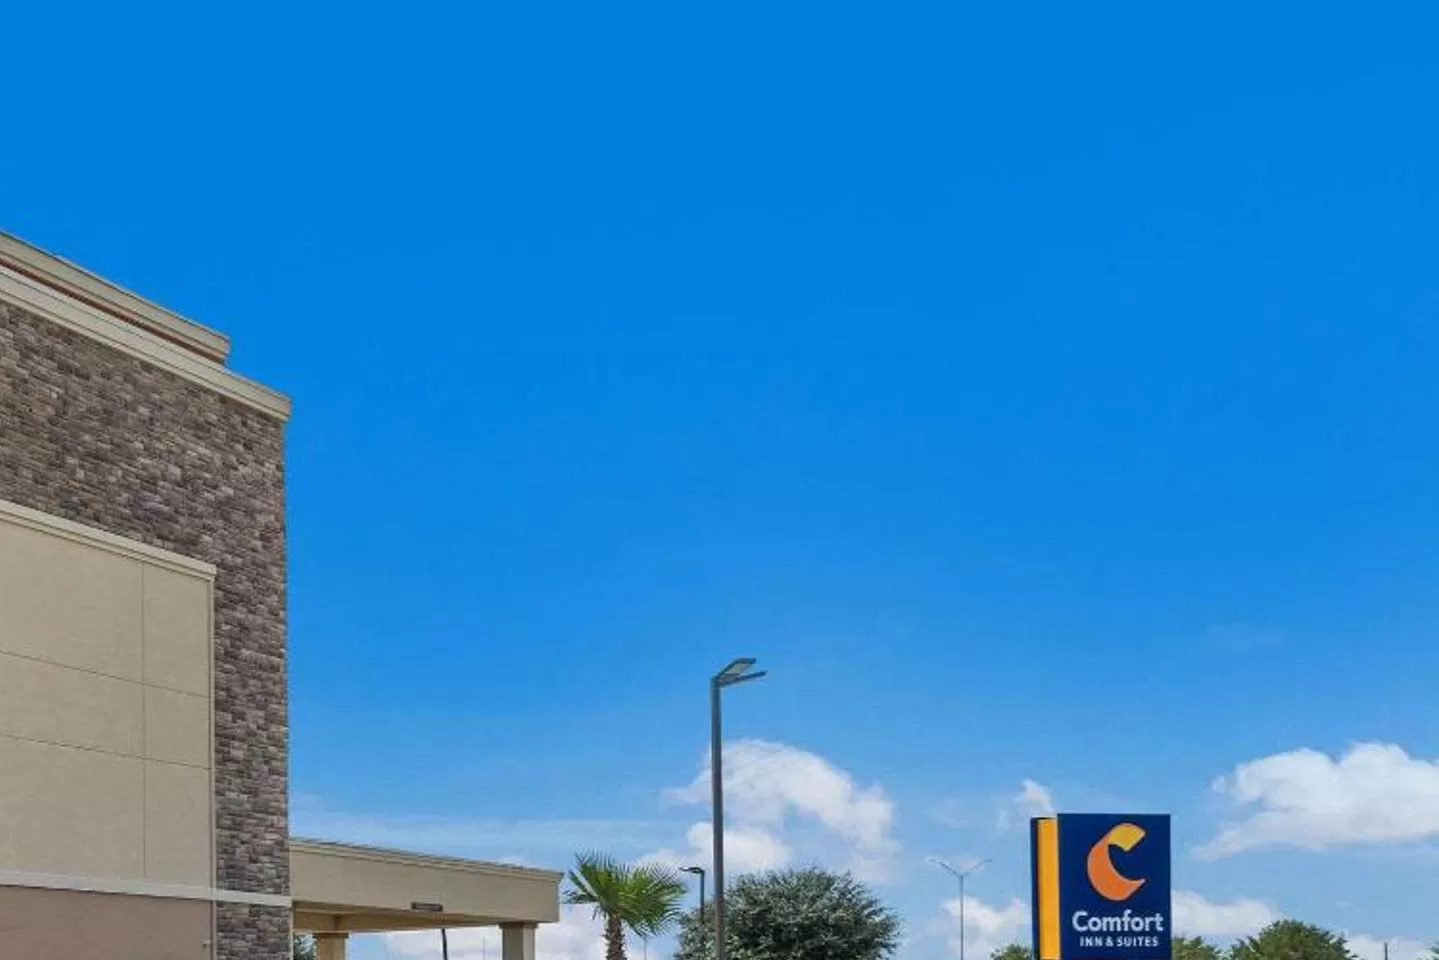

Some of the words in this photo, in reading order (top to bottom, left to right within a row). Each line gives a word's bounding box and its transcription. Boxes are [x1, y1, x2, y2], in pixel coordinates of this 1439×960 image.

[1071, 908, 1164, 932] Comfort
[1079, 935, 1103, 948] INN
[1105, 935, 1114, 948] &
[1116, 935, 1159, 948] SUITES
